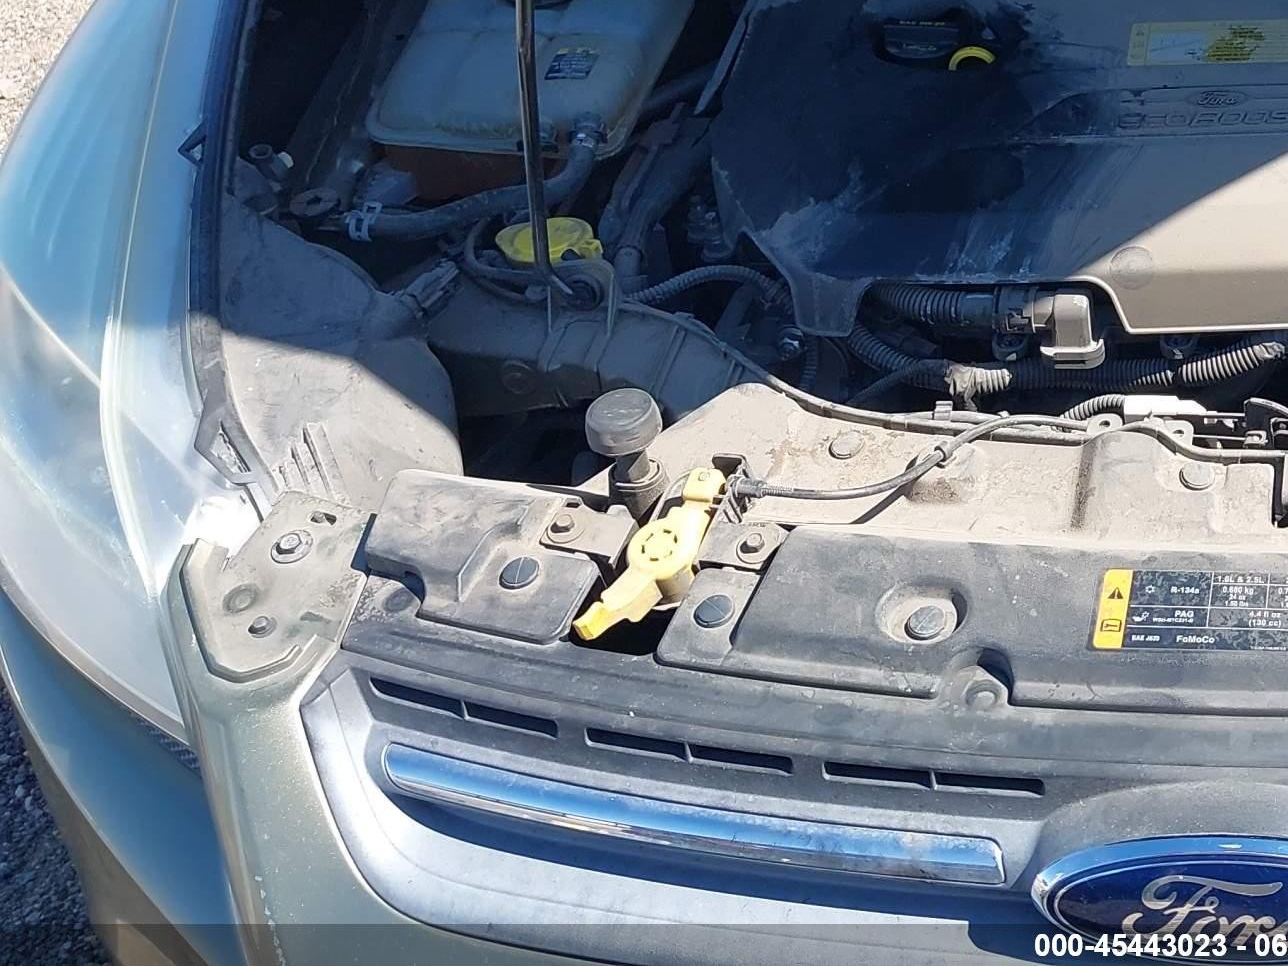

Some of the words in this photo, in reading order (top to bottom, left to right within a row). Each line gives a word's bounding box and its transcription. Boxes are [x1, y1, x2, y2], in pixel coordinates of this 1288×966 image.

[1170, 586, 1200, 594] R-134a
[1244, 586, 1254, 595] kg
[1174, 610, 1195, 618] PAG
[1176, 635, 1215, 644] FoMoCo
